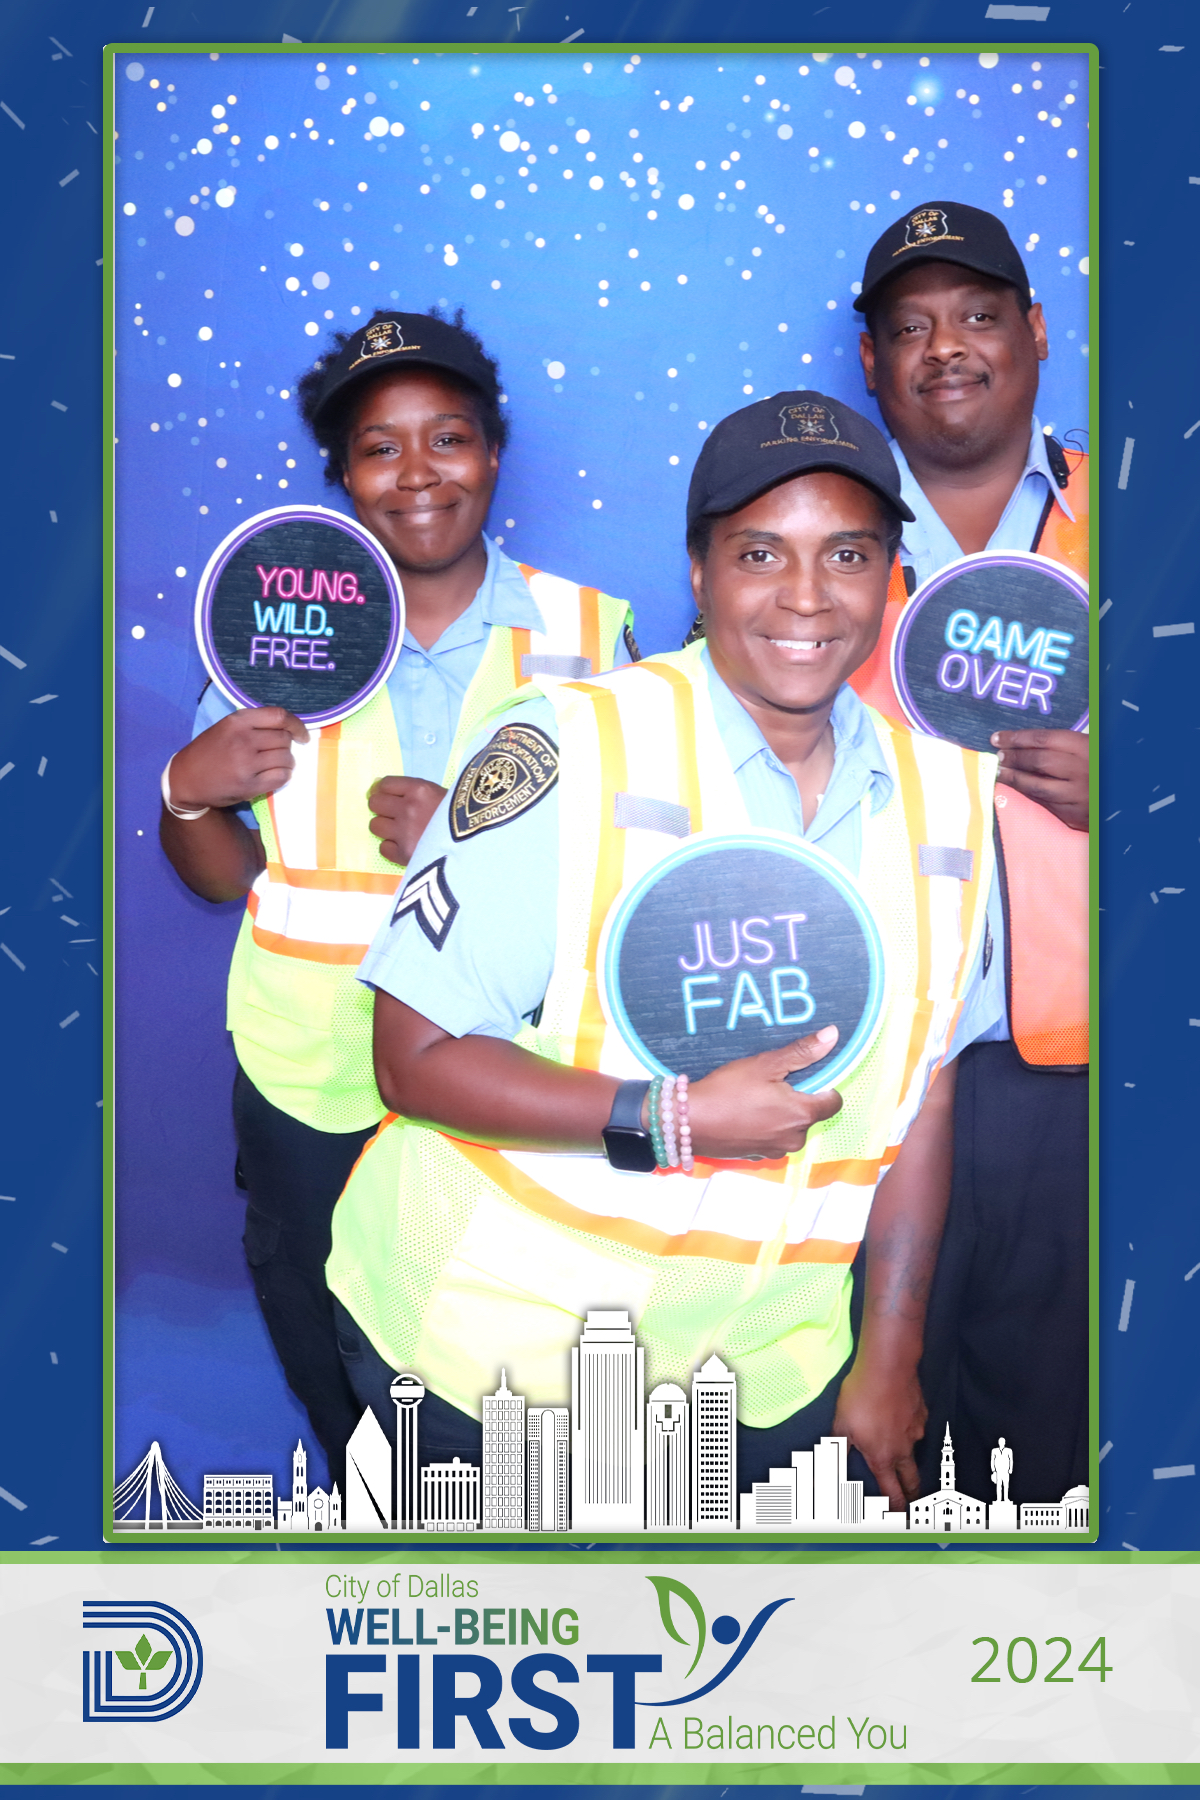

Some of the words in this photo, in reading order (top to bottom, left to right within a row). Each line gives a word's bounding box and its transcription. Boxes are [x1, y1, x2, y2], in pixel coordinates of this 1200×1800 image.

[788, 405, 810, 414] CITY
[256, 564, 365, 605] YOUNG.
[253, 600, 334, 636] WILD.
[249, 635, 336, 671] FREE.
[944, 608, 1074, 676] GAME
[936, 650, 1056, 715] OVER
[540, 754, 556, 768] OF
[469, 782, 537, 828] ENFORCEMENT
[678, 911, 808, 972] JUST
[681, 965, 817, 1035] FAB
